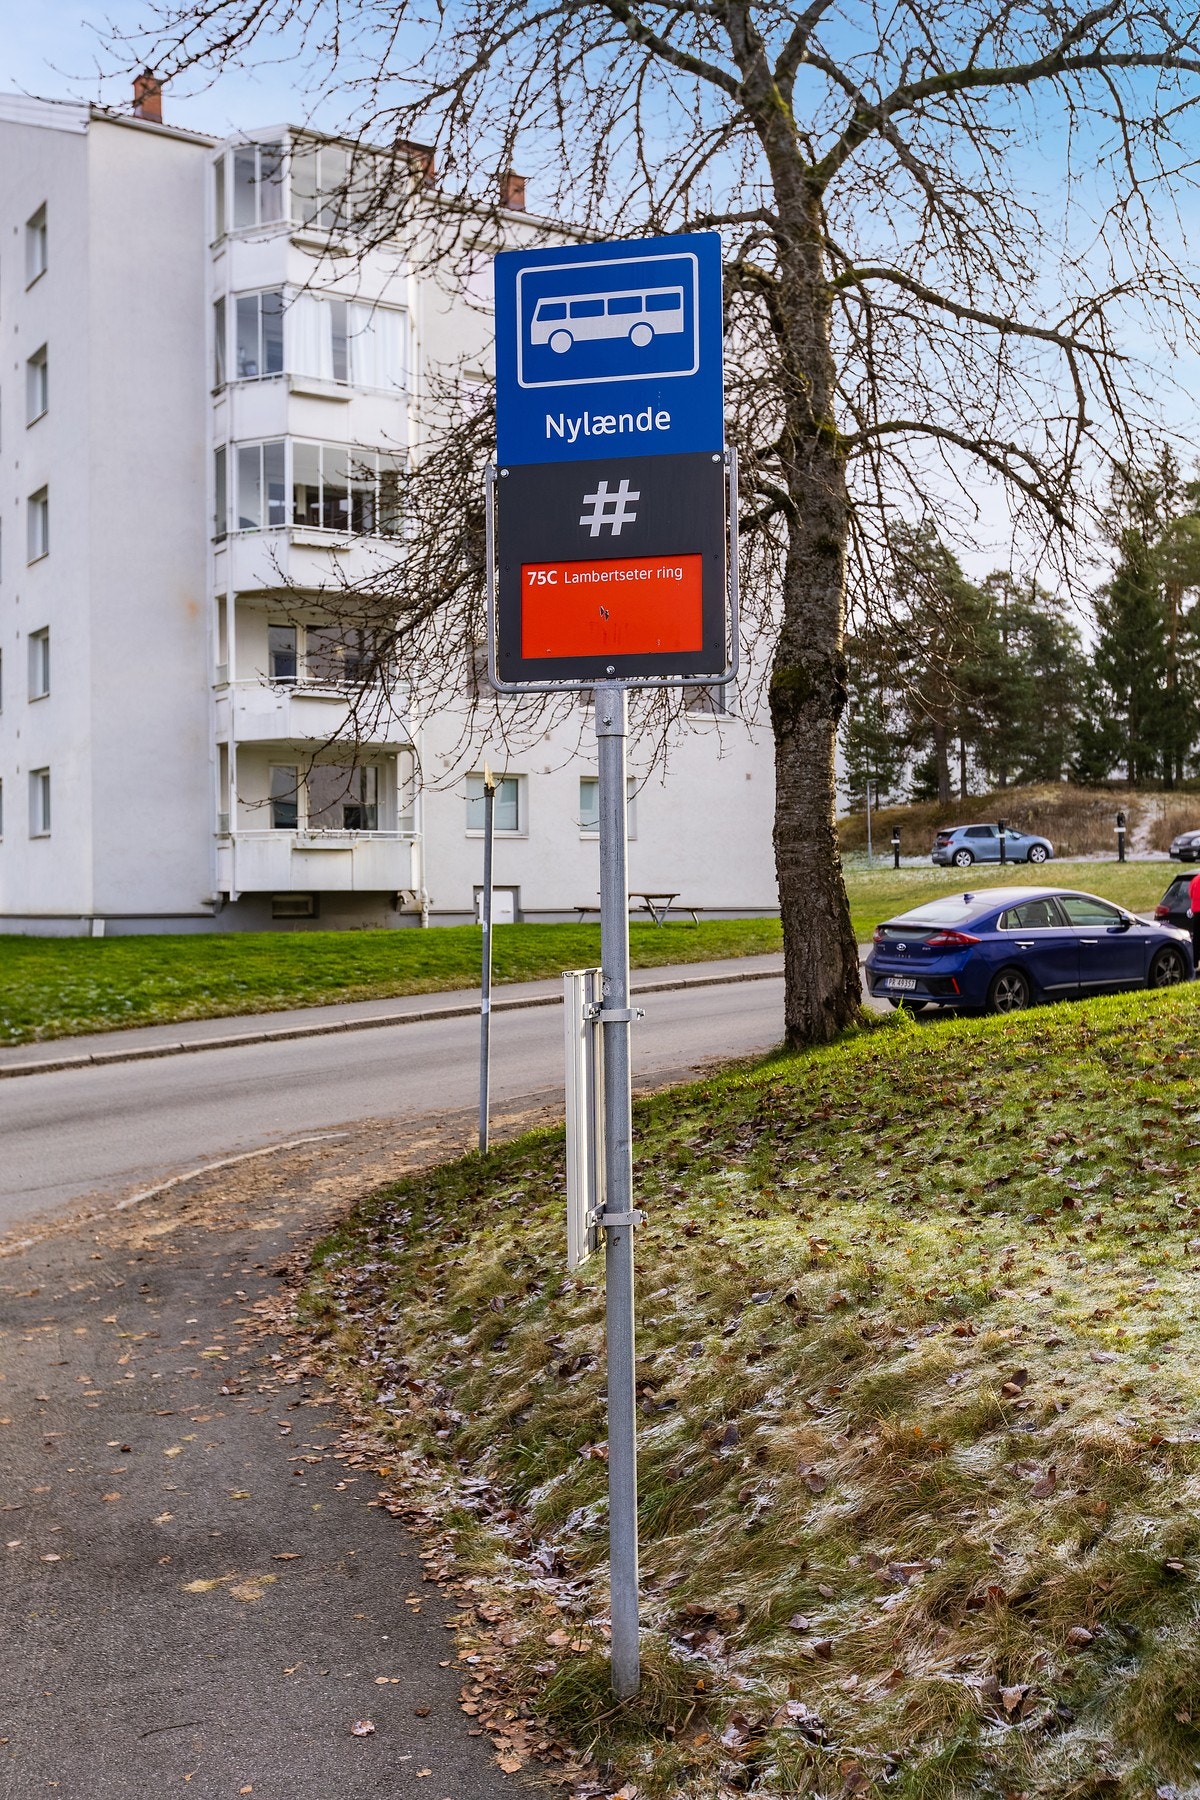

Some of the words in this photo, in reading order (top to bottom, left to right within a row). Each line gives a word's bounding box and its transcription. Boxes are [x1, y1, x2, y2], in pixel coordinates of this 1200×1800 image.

[545, 406, 671, 443] Nylænde
[527, 570, 558, 586] 75C
[564, 569, 653, 584] Lambertseter
[656, 566, 683, 581] ring
